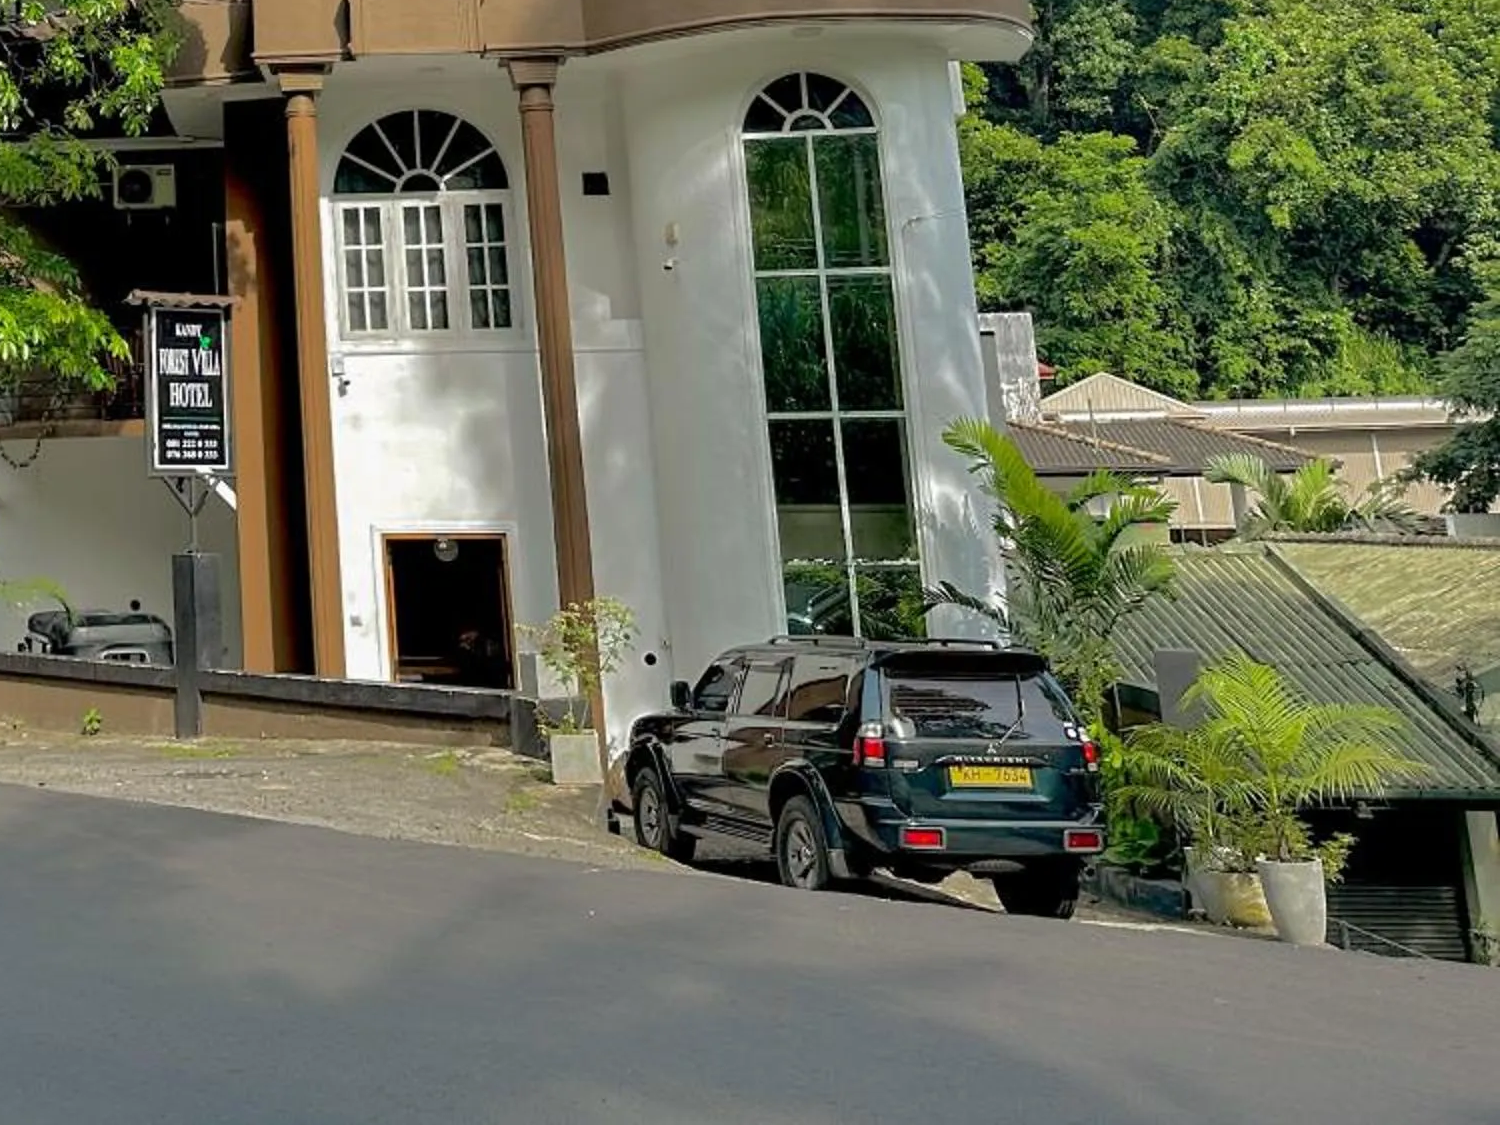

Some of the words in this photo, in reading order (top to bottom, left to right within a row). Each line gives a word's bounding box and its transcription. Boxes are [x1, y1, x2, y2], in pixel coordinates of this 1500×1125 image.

[159, 348, 189, 375] FOREST
[191, 348, 220, 376] VILLA
[169, 382, 213, 408] HOTEL
